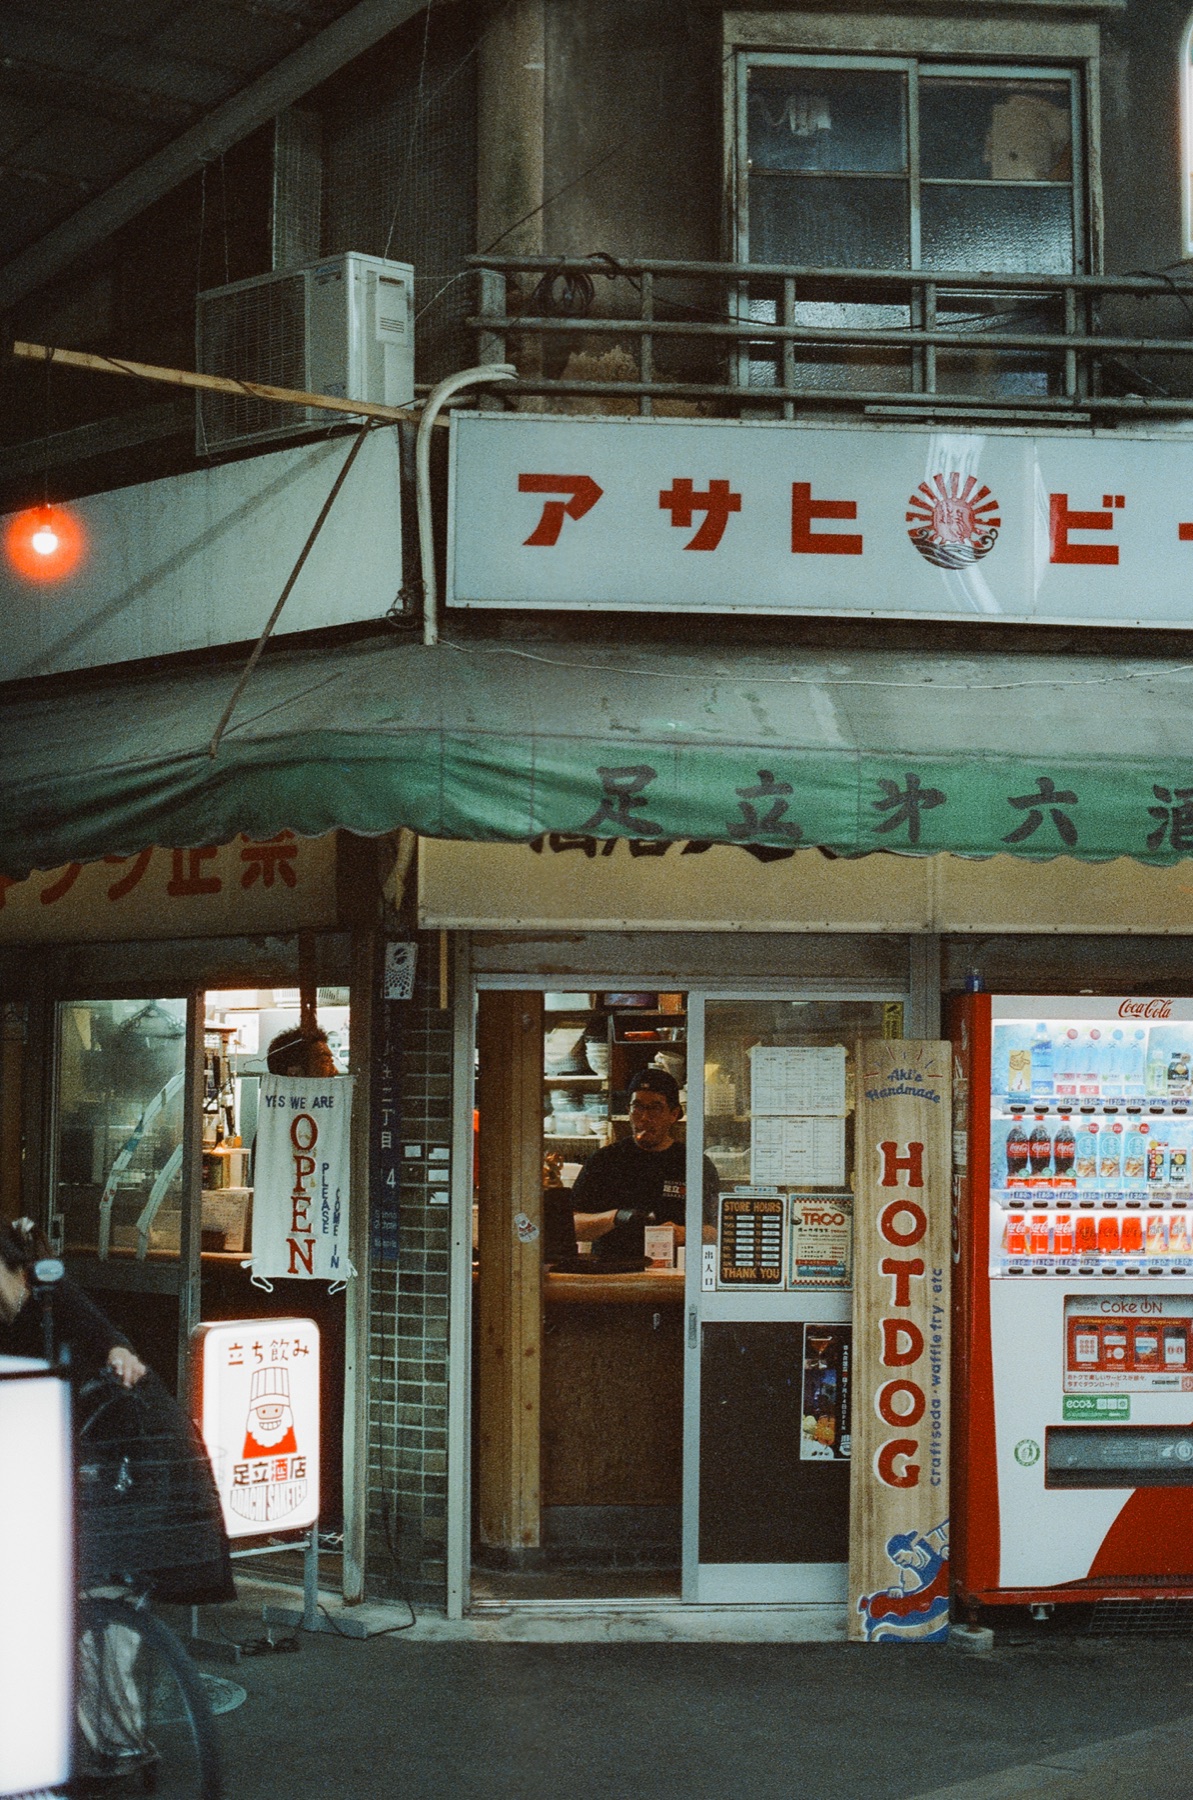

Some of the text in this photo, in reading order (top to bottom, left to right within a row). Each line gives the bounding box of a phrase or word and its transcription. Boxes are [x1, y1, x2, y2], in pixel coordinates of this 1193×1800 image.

[518, 473, 863, 554] アサヒ
[1118, 998, 1174, 1018] Coca-Cola
[290, 1096, 307, 1109] WE
[312, 1096, 334, 1109] ARE
[865, 1083, 941, 1103] Handmade
[286, 1113, 319, 1275] OPEN
[321, 1162, 331, 1235] PLEASE
[724, 1201, 782, 1213] STORE HOURS
[801, 1212, 845, 1226] TACO
[330, 1244, 340, 1269] IN
[722, 1267, 780, 1279] THANK YOU
[931, 1267, 943, 1293] etc
[929, 1304, 945, 1332] fry
[1100, 1300, 1138, 1313] Coke
[1140, 1299, 1163, 1314] ON
[228, 1339, 310, 1366] 立ち飲み
[929, 1334, 942, 1387] waffle
[232, 1456, 307, 1487] 足立酒店
